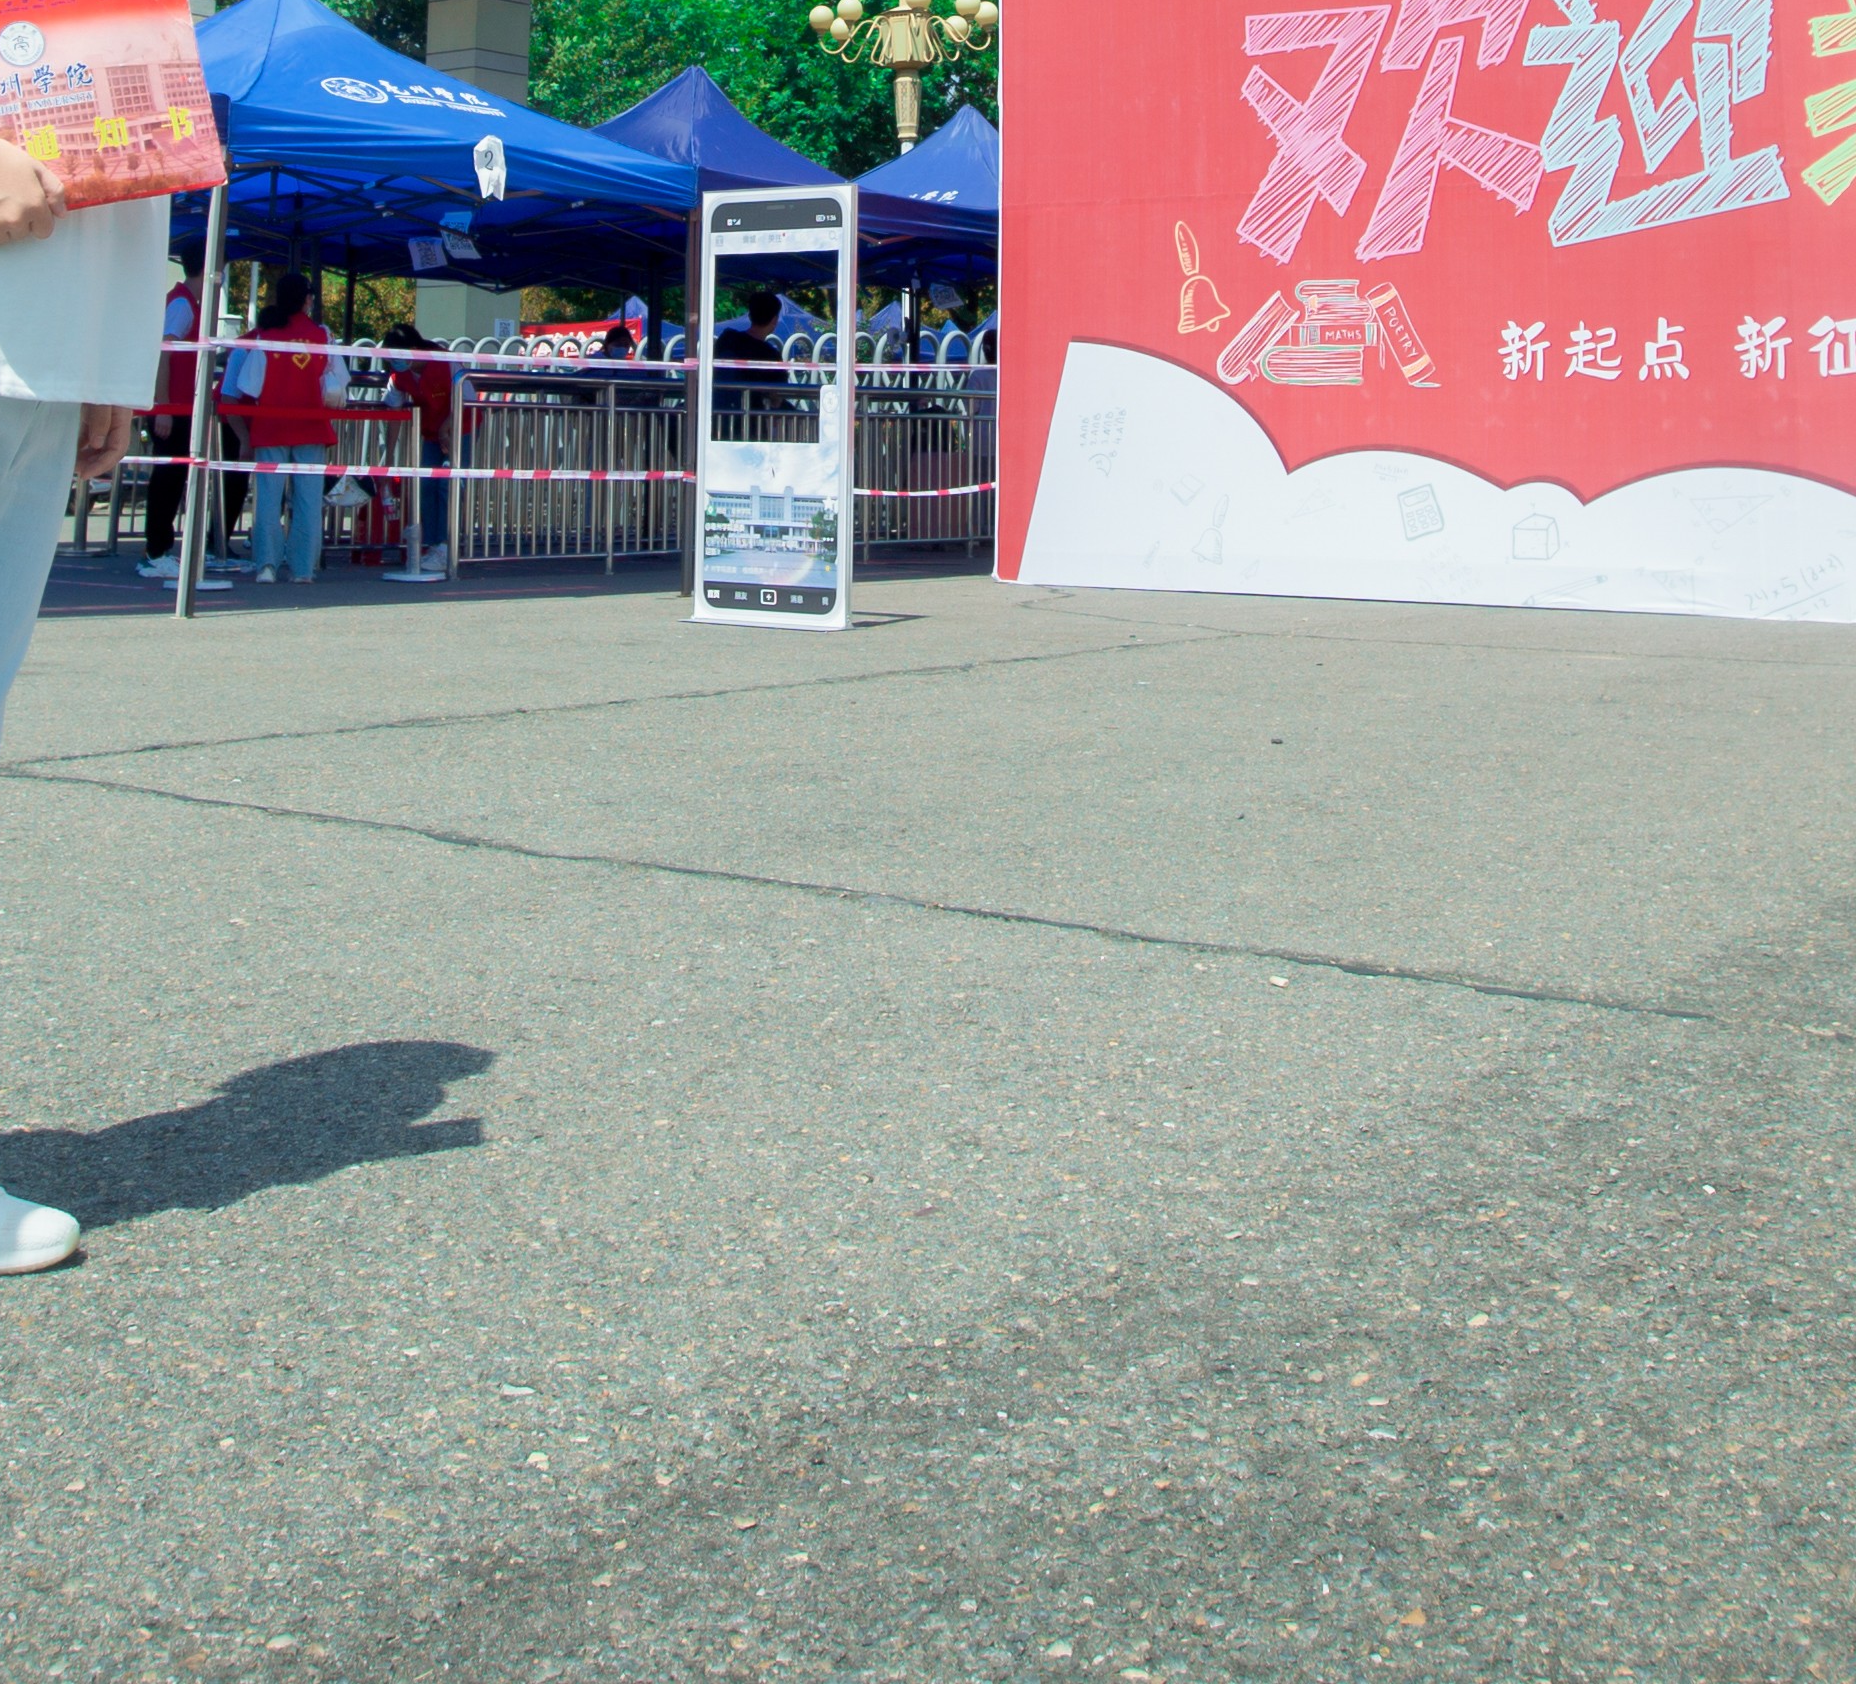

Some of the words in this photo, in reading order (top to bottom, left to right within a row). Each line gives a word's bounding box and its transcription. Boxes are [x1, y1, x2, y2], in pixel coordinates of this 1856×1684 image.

[484, 150, 494, 171] 2
[1325, 329, 1362, 341] MATHS
[1382, 306, 1419, 358] POETRY
[1497, 316, 1691, 382] 新起点
